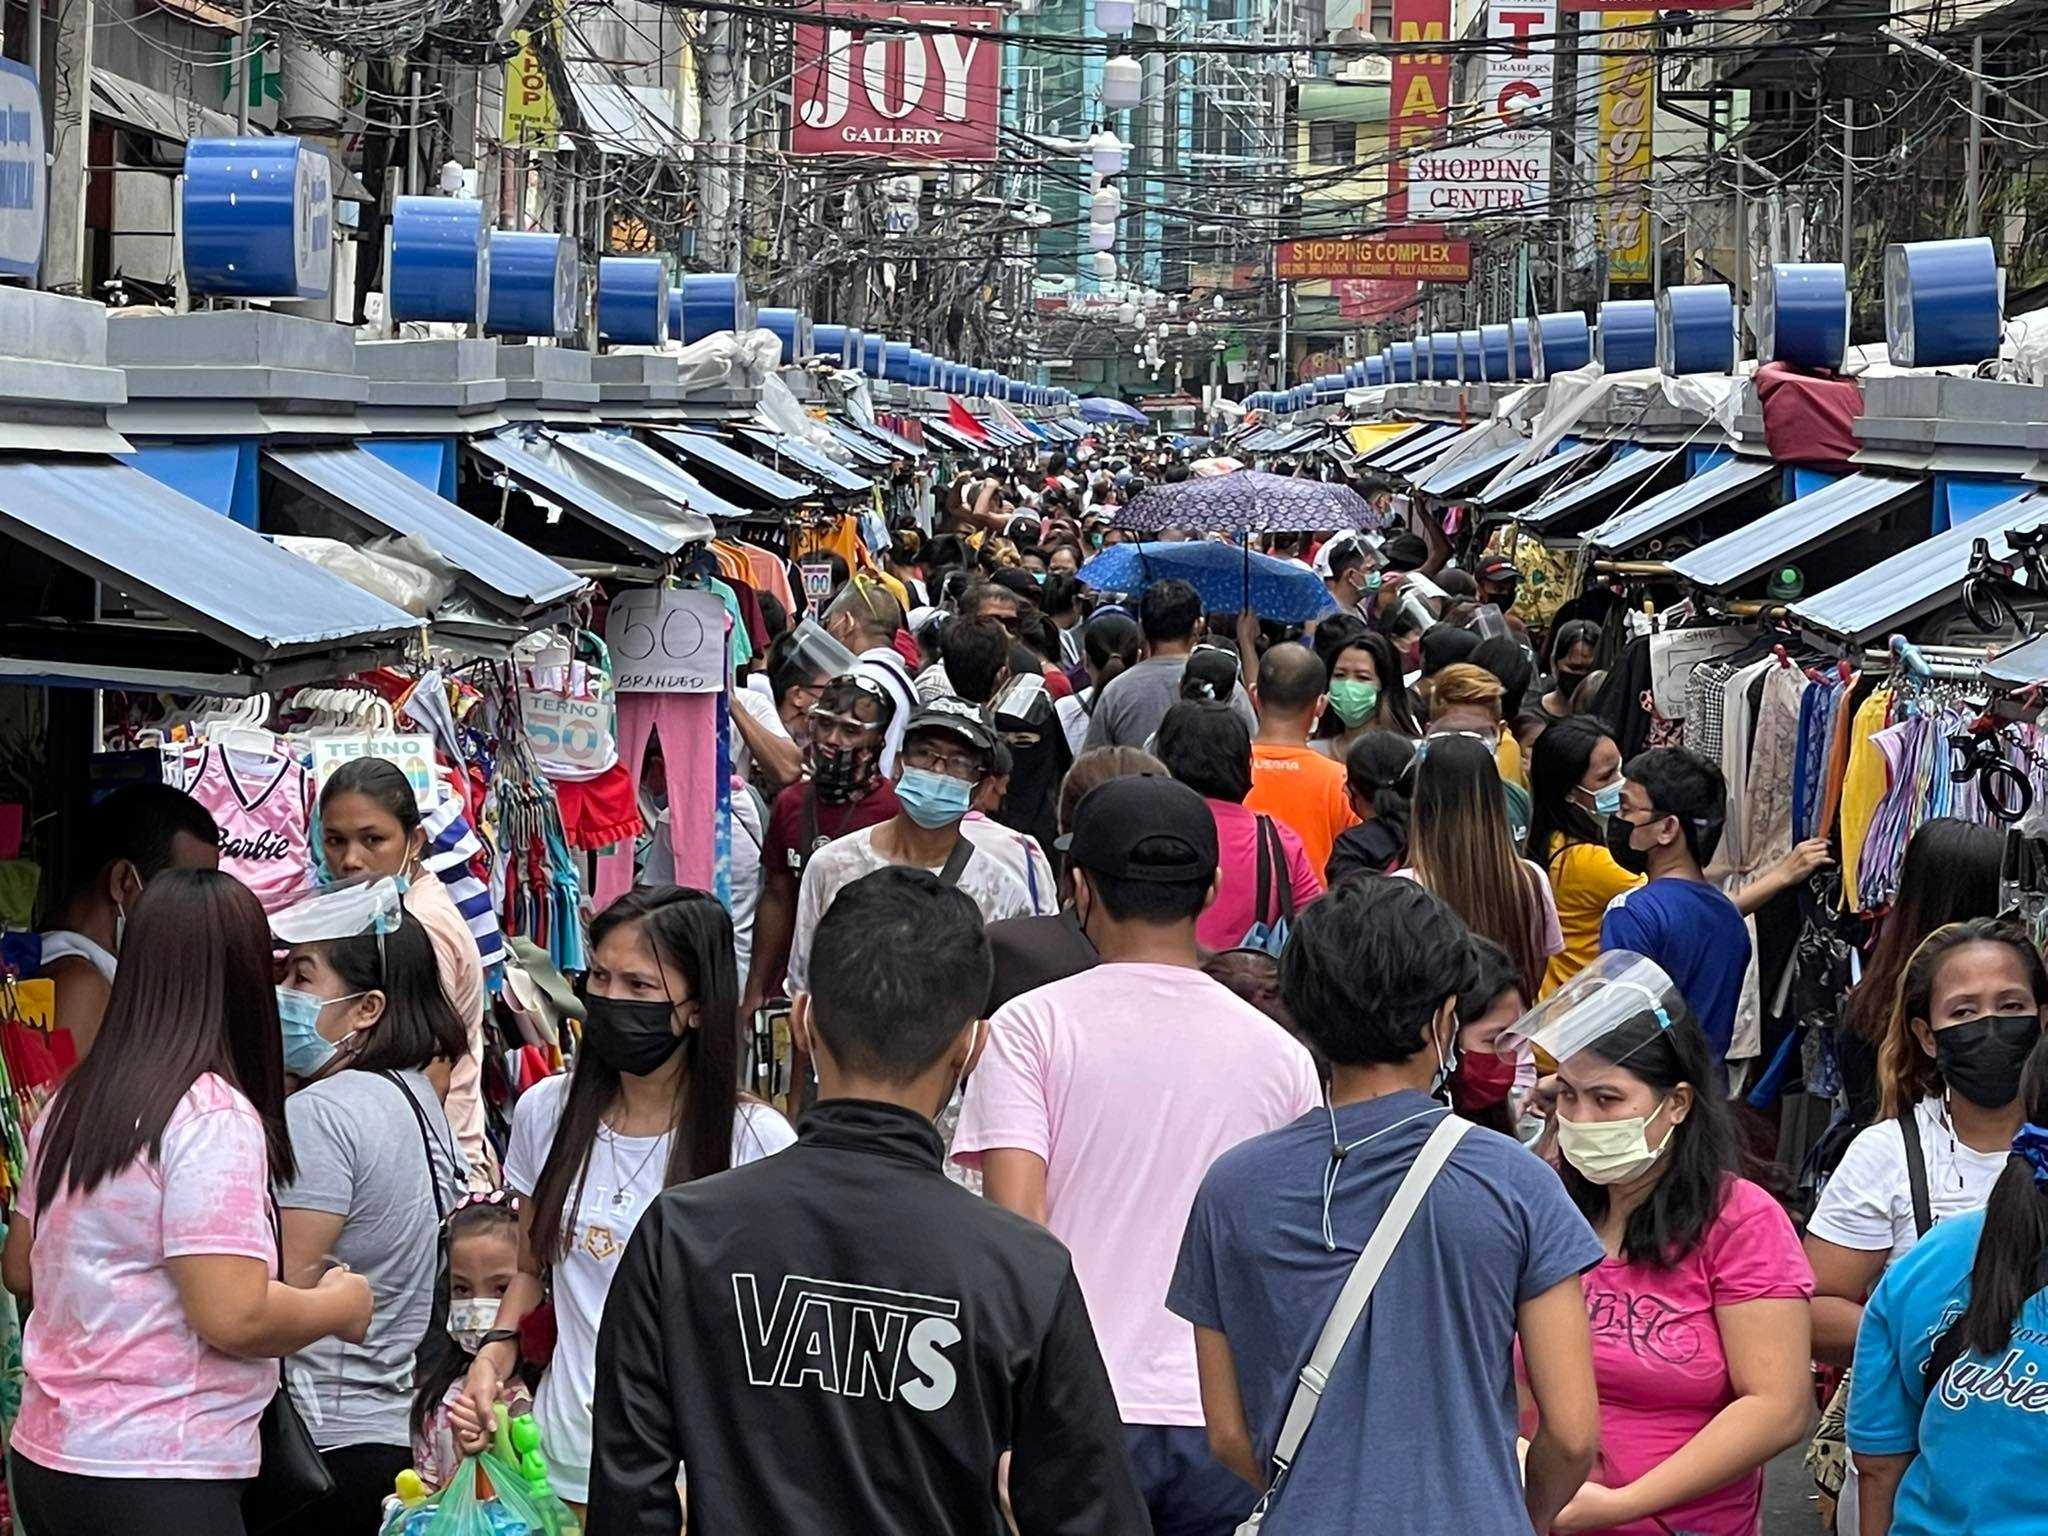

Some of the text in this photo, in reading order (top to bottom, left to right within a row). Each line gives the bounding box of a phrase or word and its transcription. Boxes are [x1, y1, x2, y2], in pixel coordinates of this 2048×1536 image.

[800, 17, 992, 129] JOY
[1491, 63, 1550, 73] TRADERS
[841, 126, 945, 145] GALLERY
[1417, 158, 1541, 181] SHOPPING
[1430, 187, 1525, 209] CENTER
[1293, 243, 1450, 263] SHOPPING COMPLEX
[804, 575, 829, 593] 100
[617, 675, 704, 688] BRANDED
[531, 696, 598, 718] TERNO
[526, 712, 598, 760] 50
[325, 741, 420, 756] TERNO
[217, 827, 290, 860] Barbie
[732, 1273, 962, 1411] VANS
